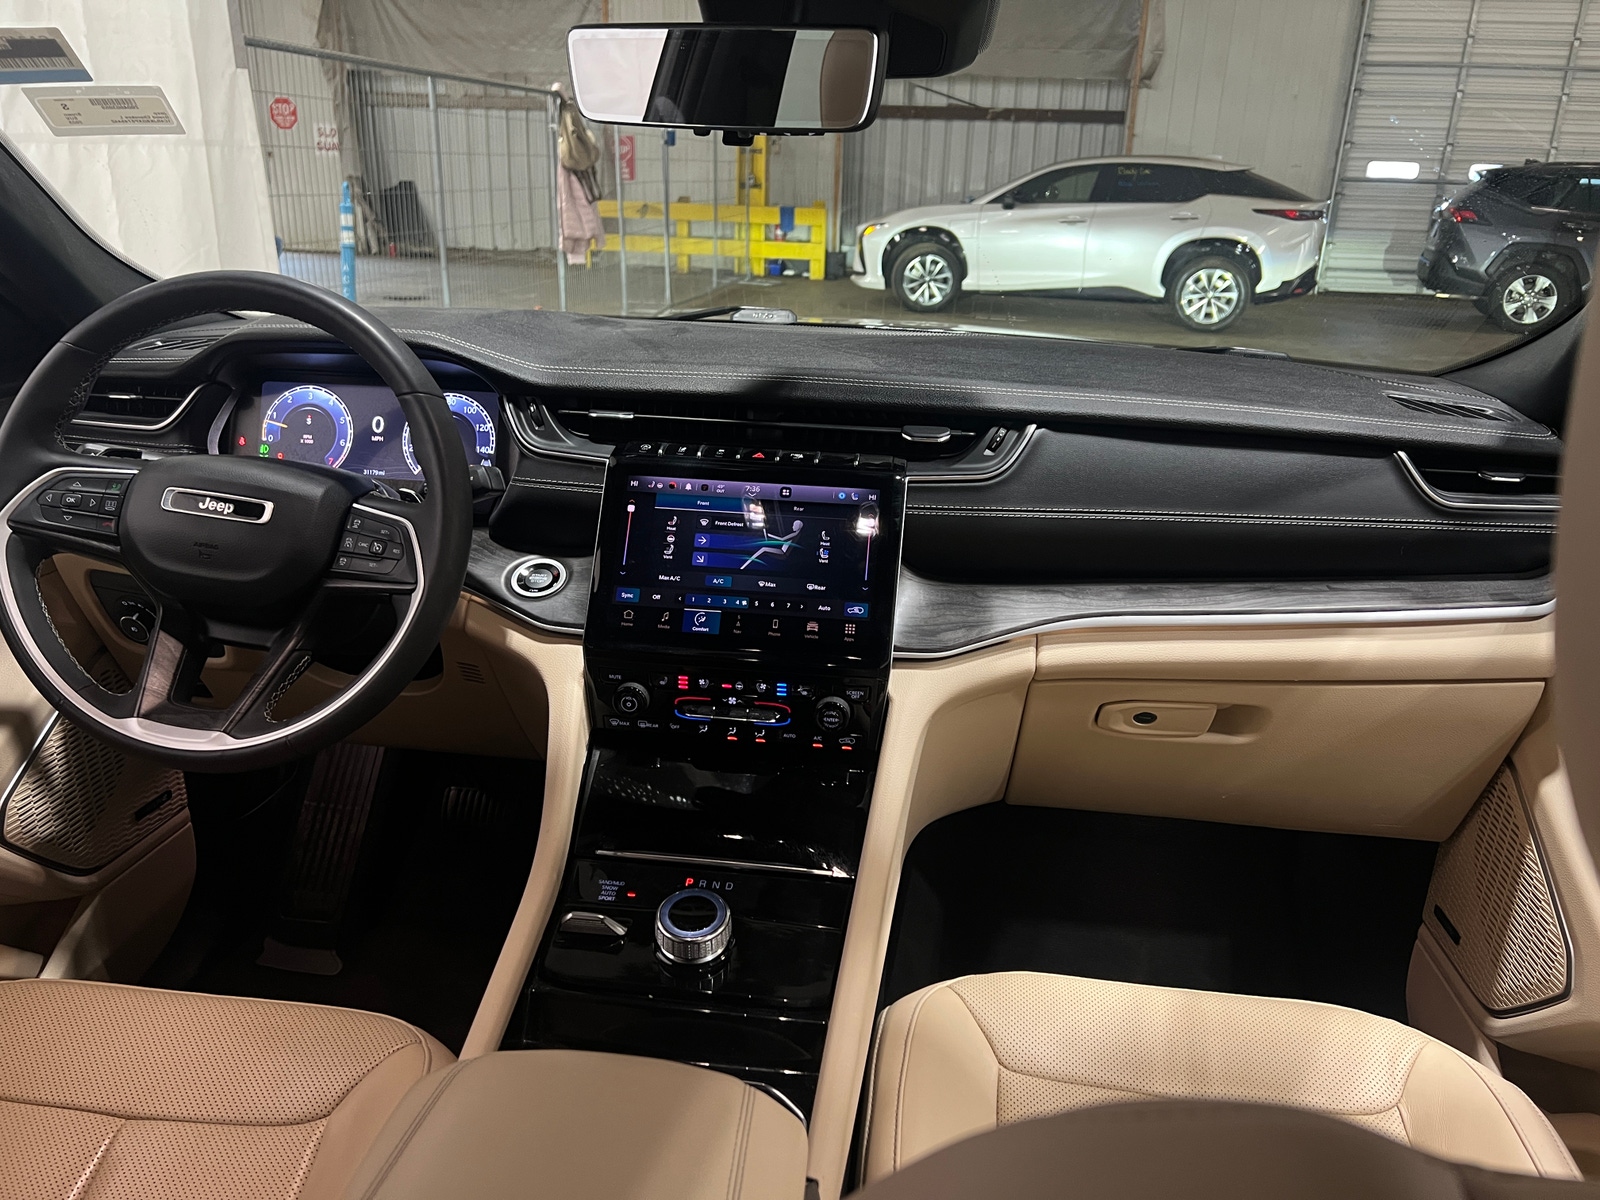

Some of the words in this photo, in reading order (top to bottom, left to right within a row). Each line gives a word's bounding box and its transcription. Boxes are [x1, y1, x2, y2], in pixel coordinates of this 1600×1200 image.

[272, 103, 295, 114] STOP
[463, 406, 477, 414] 100
[372, 416, 384, 433] 0
[476, 424, 490, 432] 120
[476, 446, 490, 454] 140
[198, 497, 234, 514] Jeep
[686, 878, 694, 887] P
[699, 880, 707, 888] R
[726, 882, 733, 890] D
